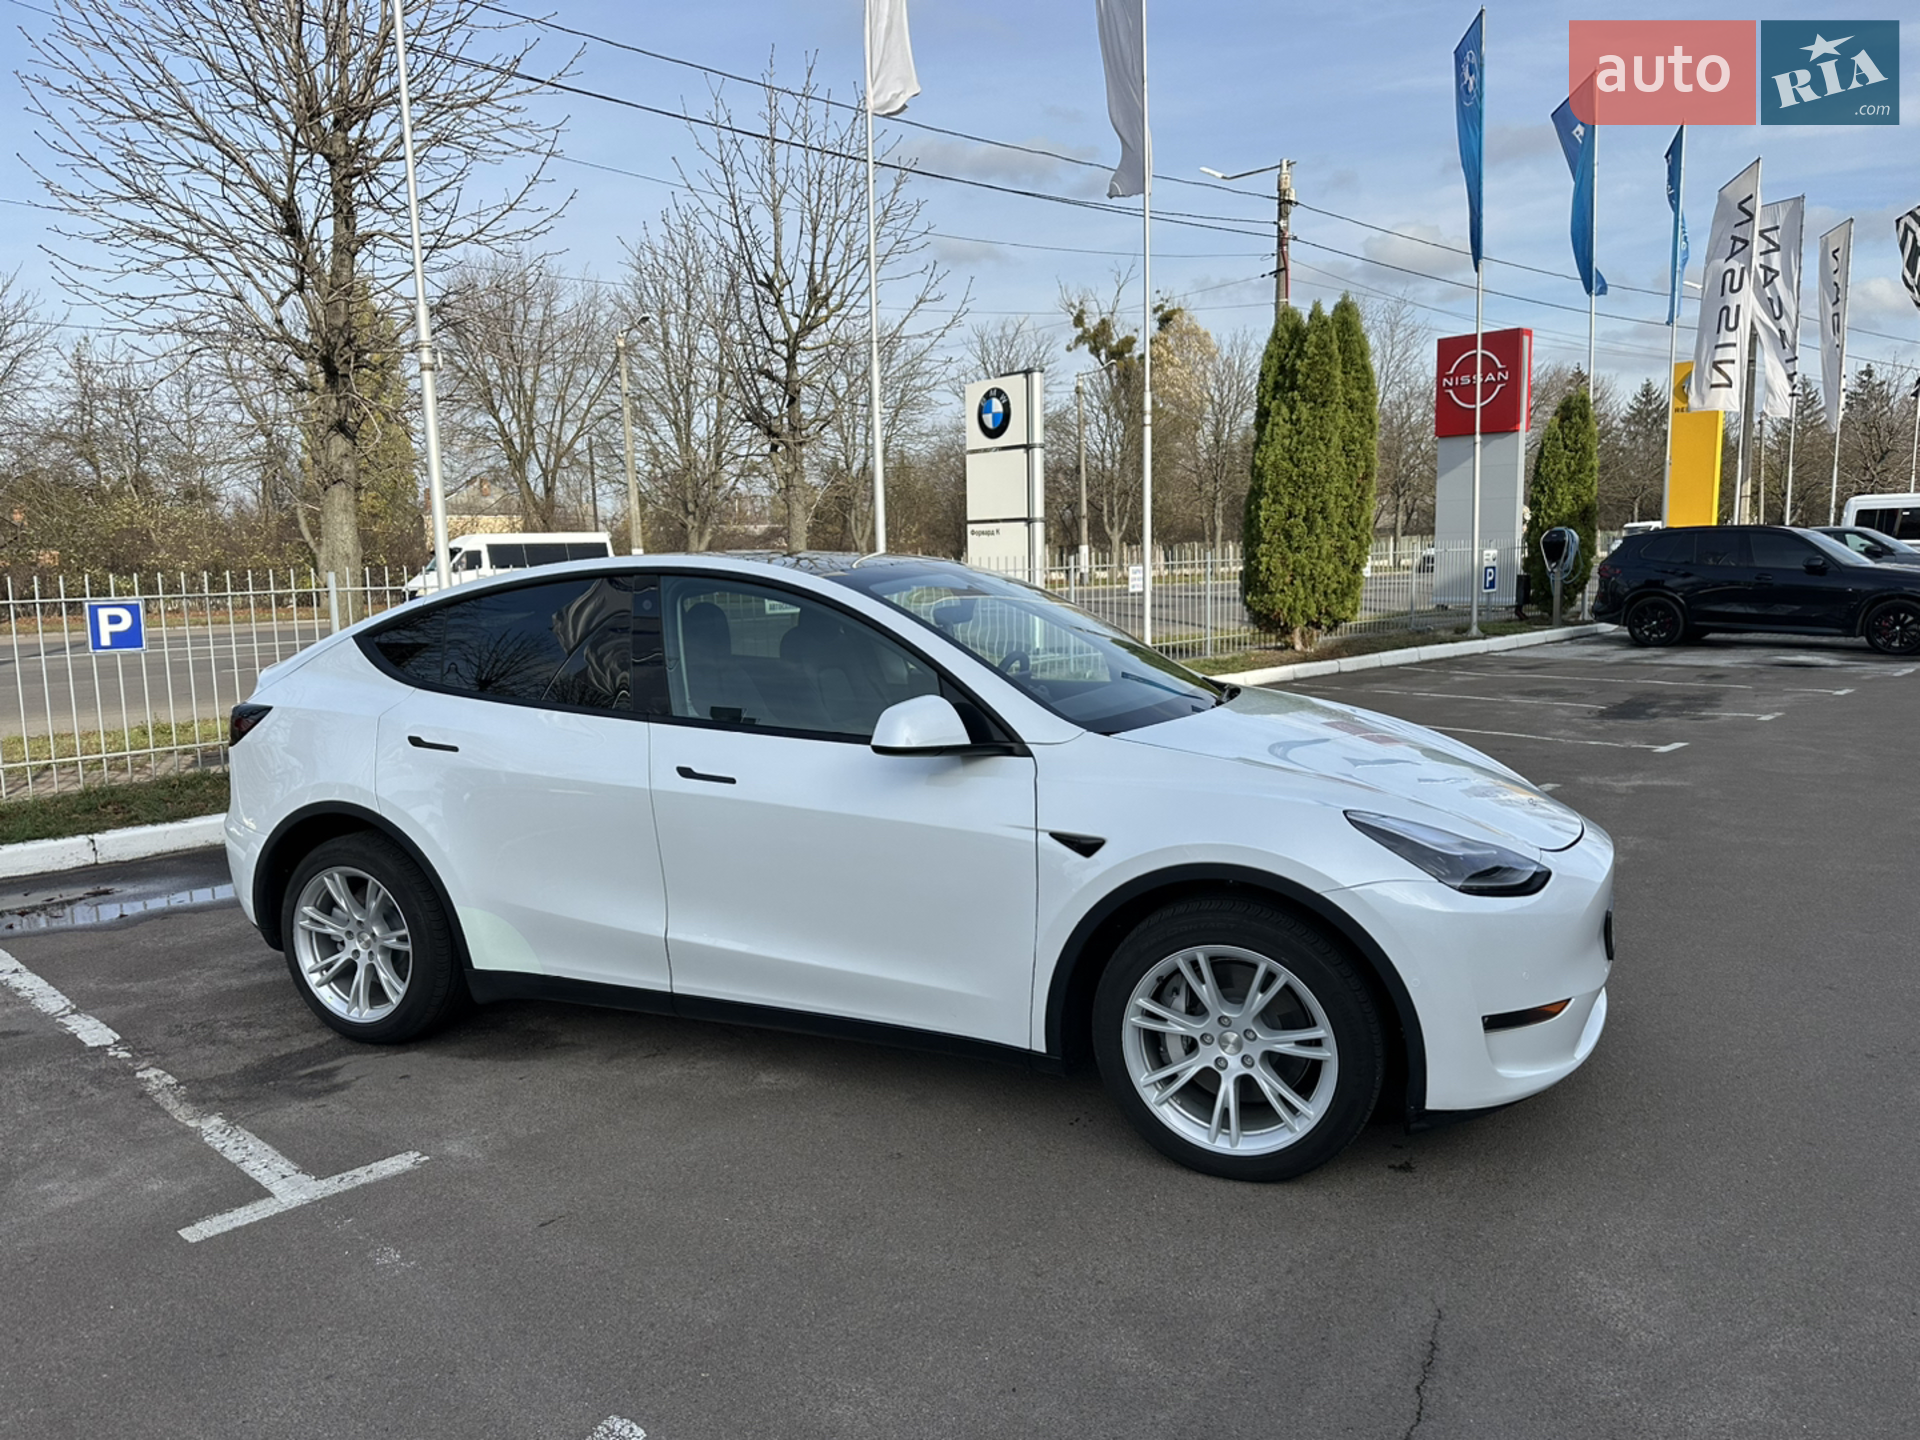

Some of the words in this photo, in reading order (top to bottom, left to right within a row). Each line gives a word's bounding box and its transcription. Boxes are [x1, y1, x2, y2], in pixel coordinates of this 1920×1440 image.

[1442, 370, 1509, 388] NISSAN
[980, 388, 1008, 406] BMW
[1486, 568, 1494, 588] P
[97, 607, 133, 647] P
